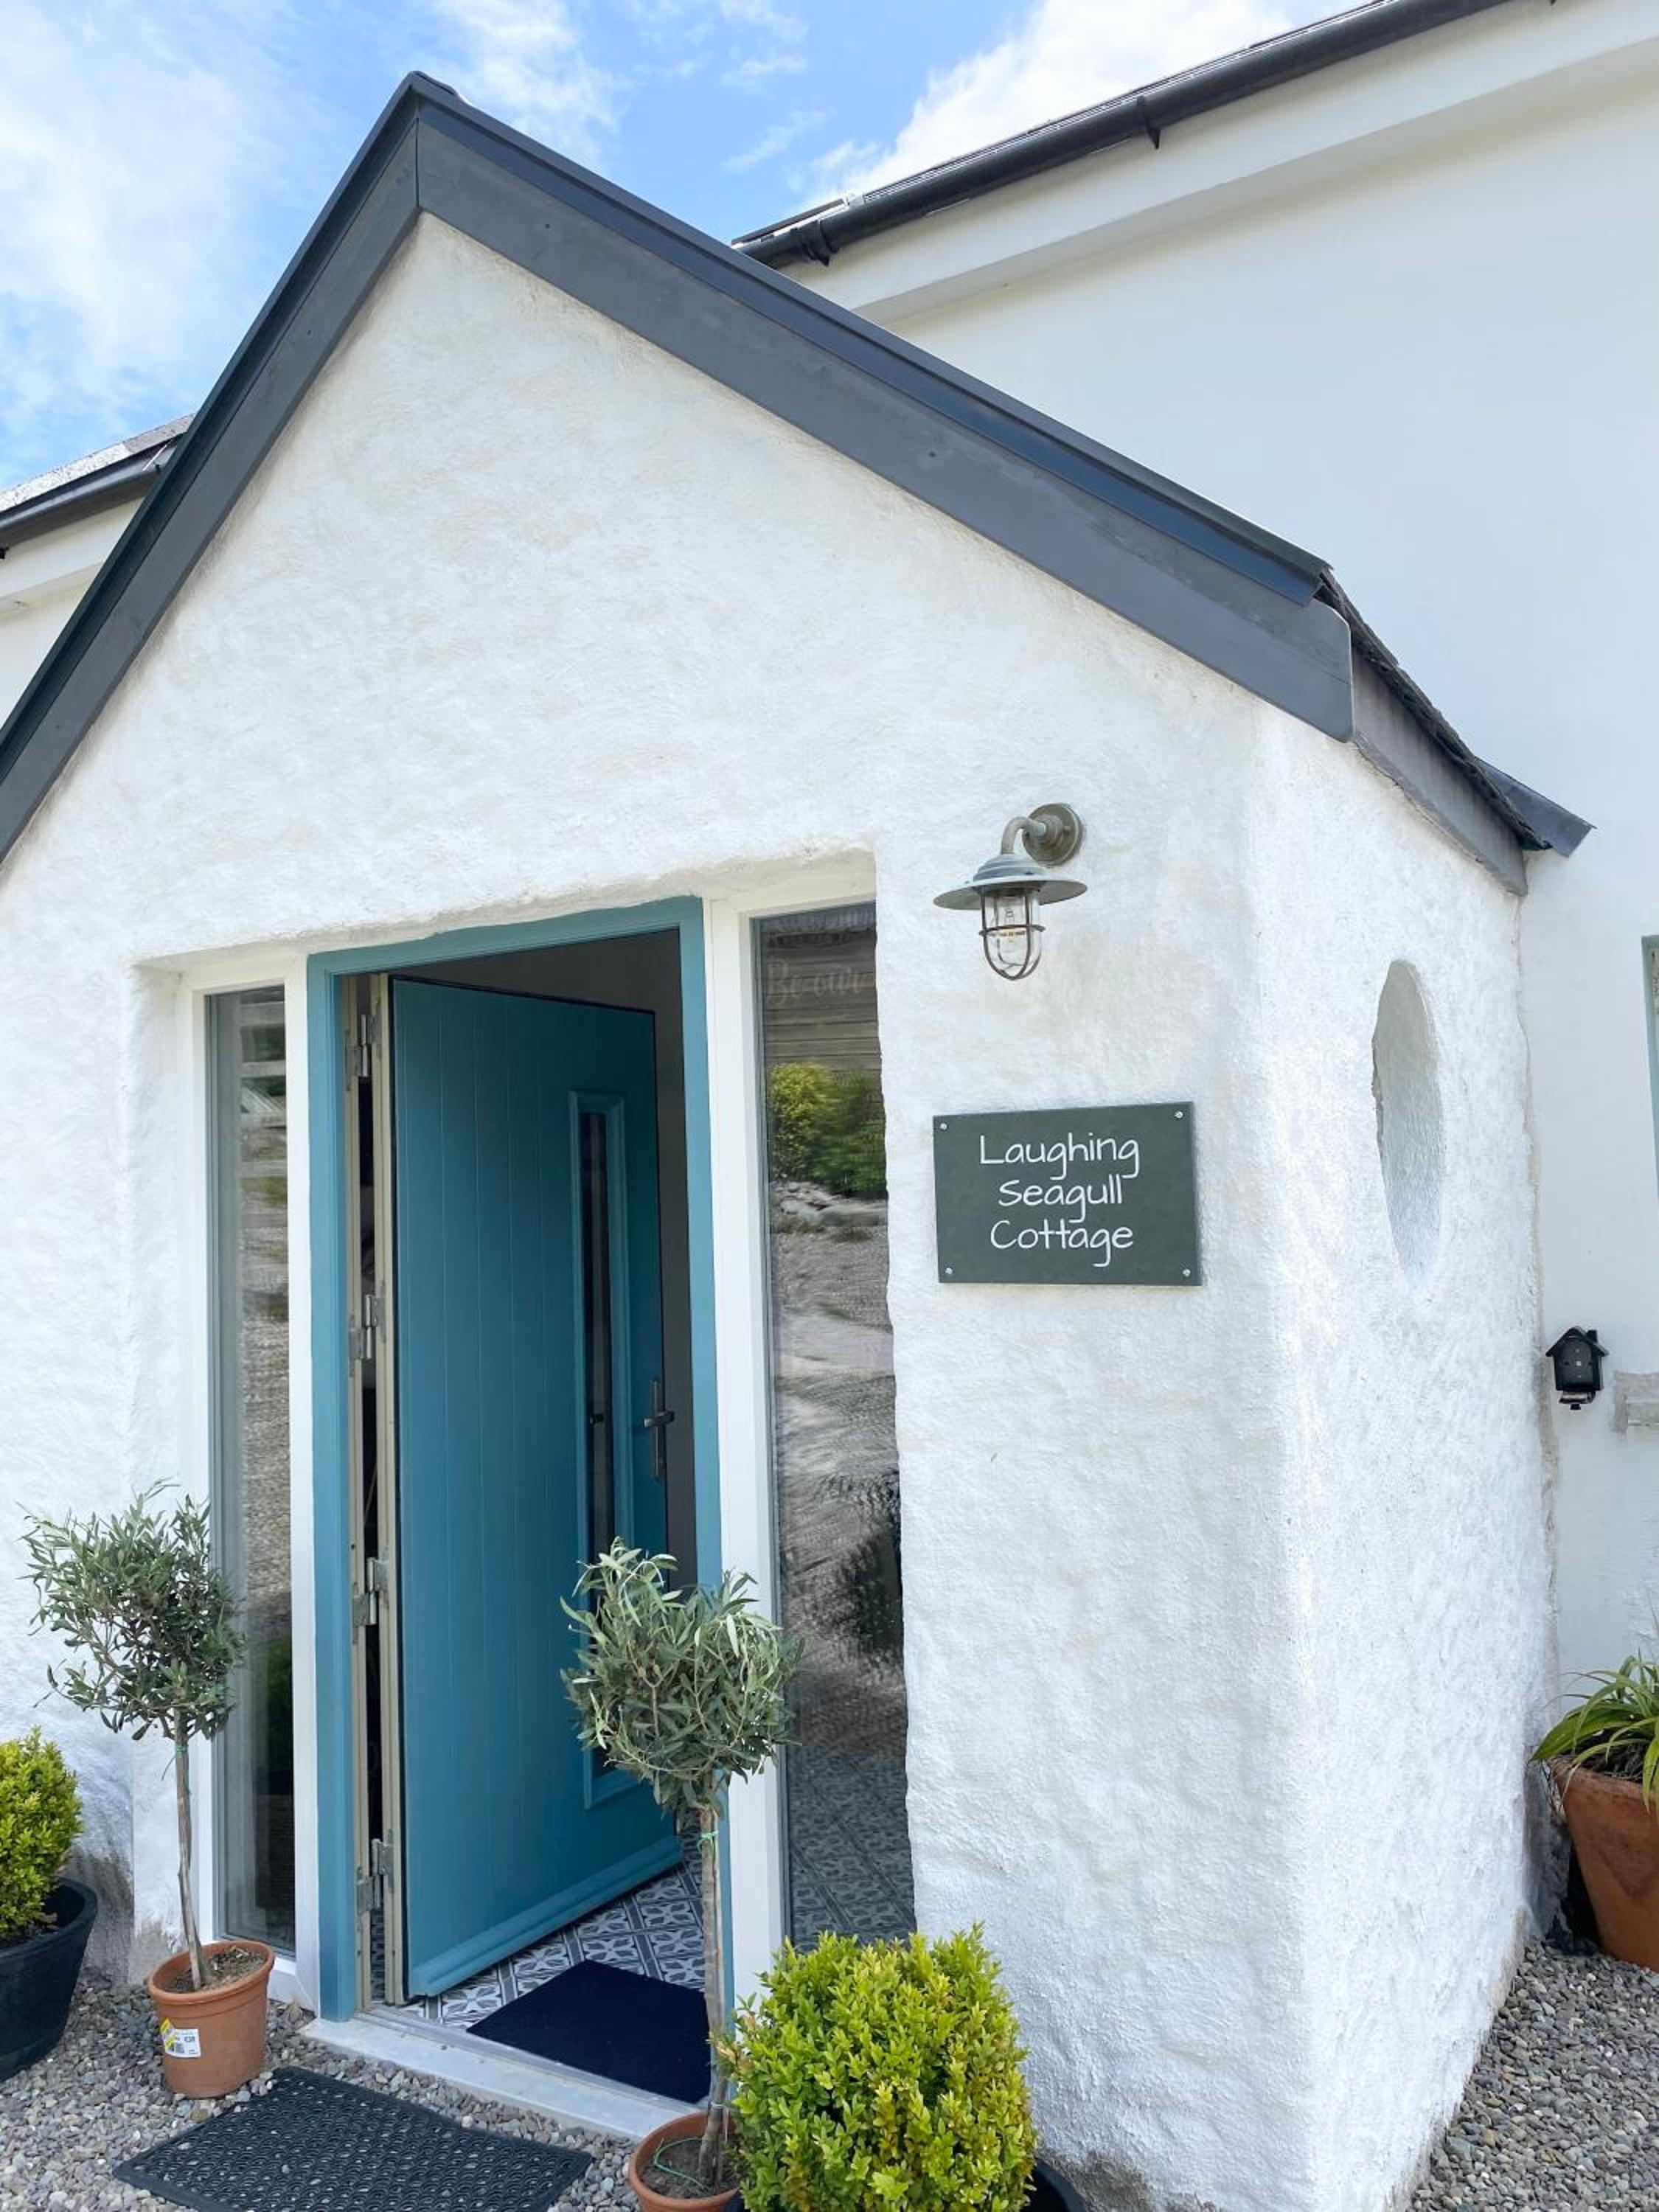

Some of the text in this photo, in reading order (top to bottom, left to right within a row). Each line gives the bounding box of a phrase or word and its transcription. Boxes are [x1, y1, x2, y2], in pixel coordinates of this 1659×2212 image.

[980, 1132, 1140, 1180] Laughing
[998, 1173, 1123, 1223] Seagull
[990, 1218, 1133, 1267] Cottage
